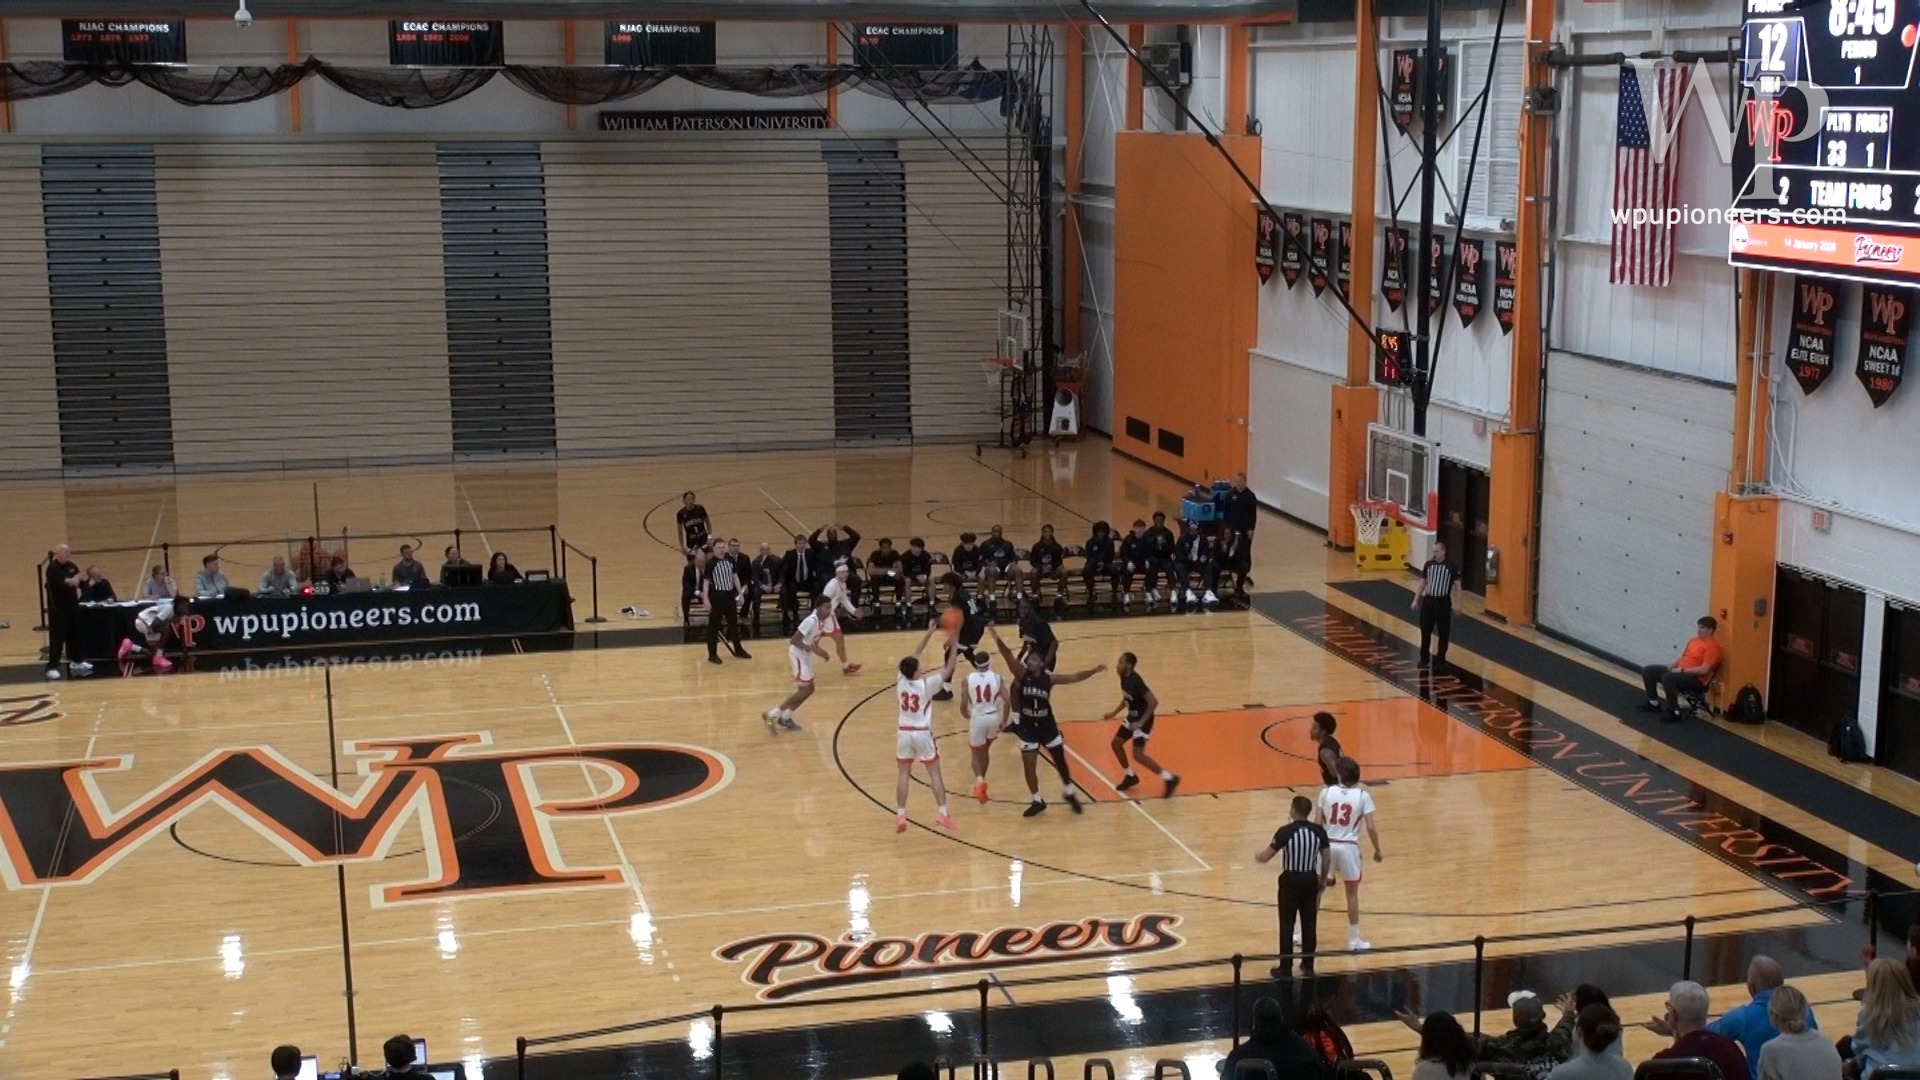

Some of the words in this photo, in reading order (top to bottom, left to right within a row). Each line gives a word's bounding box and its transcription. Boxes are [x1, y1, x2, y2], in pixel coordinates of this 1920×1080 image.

[79, 22, 104, 31] NJAC
[108, 23, 170, 33] CHAMPIONS
[403, 22, 429, 31] ECAC
[432, 22, 489, 31] CHAMPIONS
[1829, 0, 1895, 36] 8:45
[619, 24, 642, 33] NJAC
[646, 24, 701, 33] CHAMPIONS
[866, 26, 889, 35] ECAC
[892, 26, 945, 35] CHAMPIONS
[1758, 23, 1788, 71] 12
[1841, 40, 1877, 58] PERIOD
[1854, 65, 1862, 85] 1
[604, 116, 668, 131] WILLIAM
[673, 116, 743, 131] PATERSON
[747, 115, 829, 129] UNIVERSITY
[1745, 101, 1793, 161] WP
[1856, 113, 1888, 133] FOULS
[1827, 140, 1847, 167] 33
[1866, 142, 1875, 167] 1
[1778, 176, 1790, 205] 2
[1810, 180, 1847, 207] TEAM
[1849, 183, 1893, 211] FOULS
[1799, 334, 1824, 351] NCAA
[1810, 352, 1830, 366] EIGHT
[1869, 345, 1898, 362] NCAA
[1799, 364, 1821, 379] 1977
[1864, 361, 1890, 375] SWEET
[213, 602, 482, 639] wpupioneers.com
[901, 692, 920, 713] 33
[975, 683, 992, 703] 14
[1403, 674, 1600, 760] PATERSON
[1330, 802, 1353, 827] 13
[1575, 760, 1854, 897] UNIVERSITY
[713, 914, 1184, 1000] Pioneers
